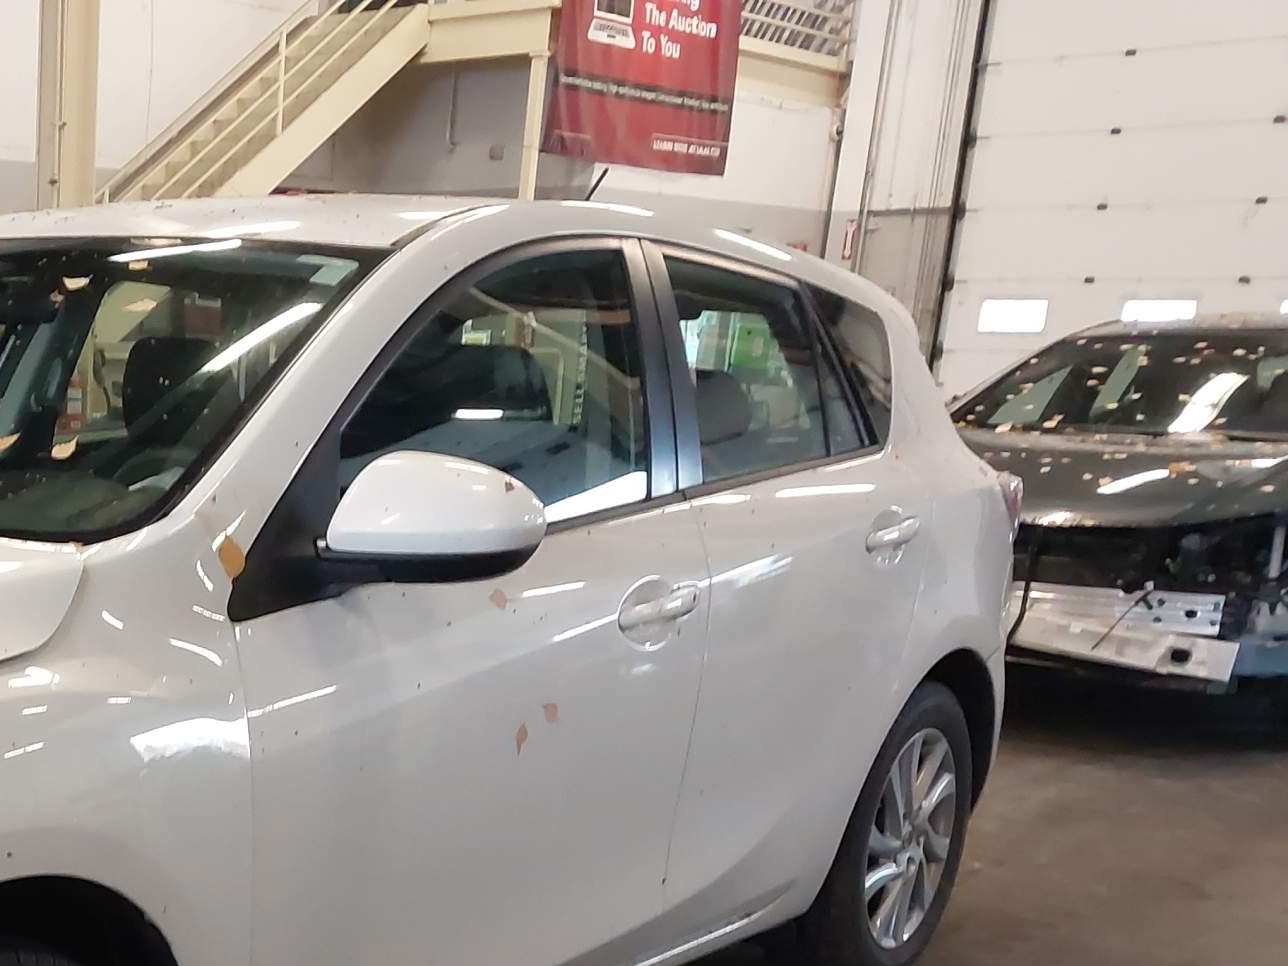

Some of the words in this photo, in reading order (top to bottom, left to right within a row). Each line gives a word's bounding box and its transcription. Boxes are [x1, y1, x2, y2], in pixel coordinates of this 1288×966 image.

[645, 2, 667, 28] The
[669, 8, 717, 39] Auction
[642, 30, 656, 54] To
[660, 33, 681, 59] You
